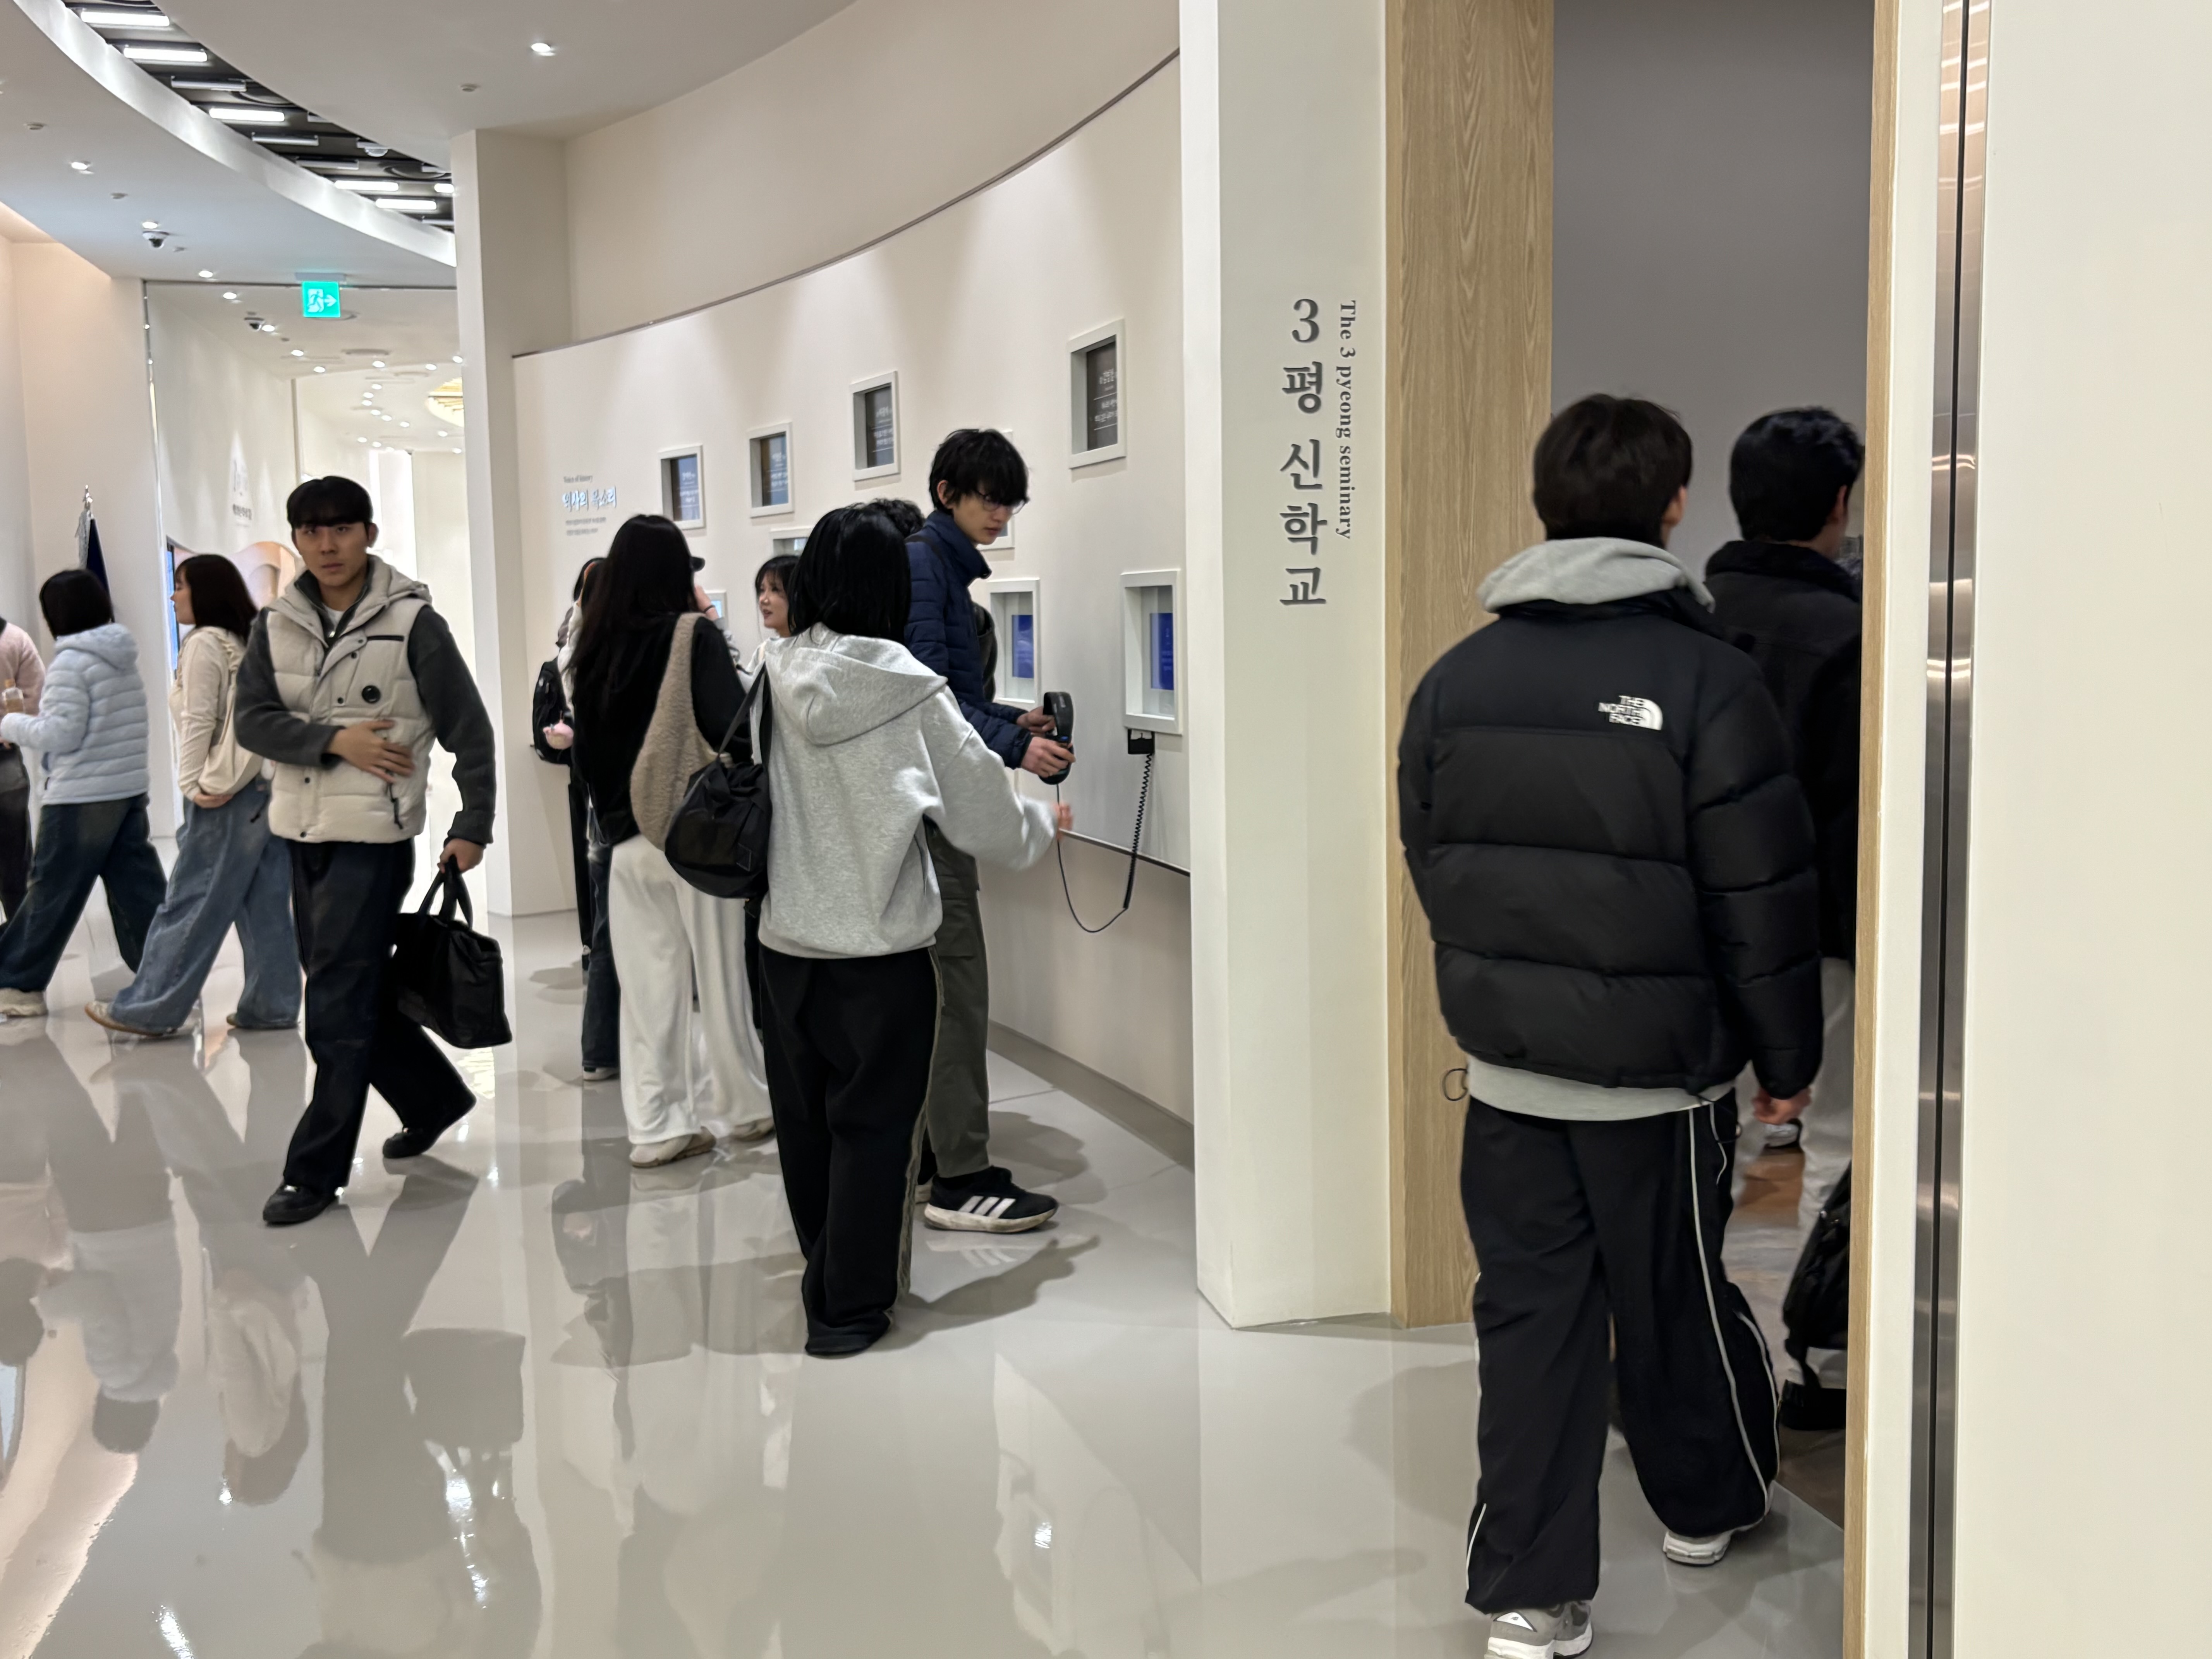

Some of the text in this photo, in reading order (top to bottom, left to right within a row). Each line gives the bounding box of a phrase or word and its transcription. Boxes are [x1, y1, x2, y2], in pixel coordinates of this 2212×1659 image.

[1336, 300, 1356, 539] The 3 pyeong seminary
[1279, 439, 1328, 605] 신학교
[1619, 695, 1644, 706] THE
[1598, 702, 1642, 716] NORTH
[1609, 713, 1641, 726] FACE
